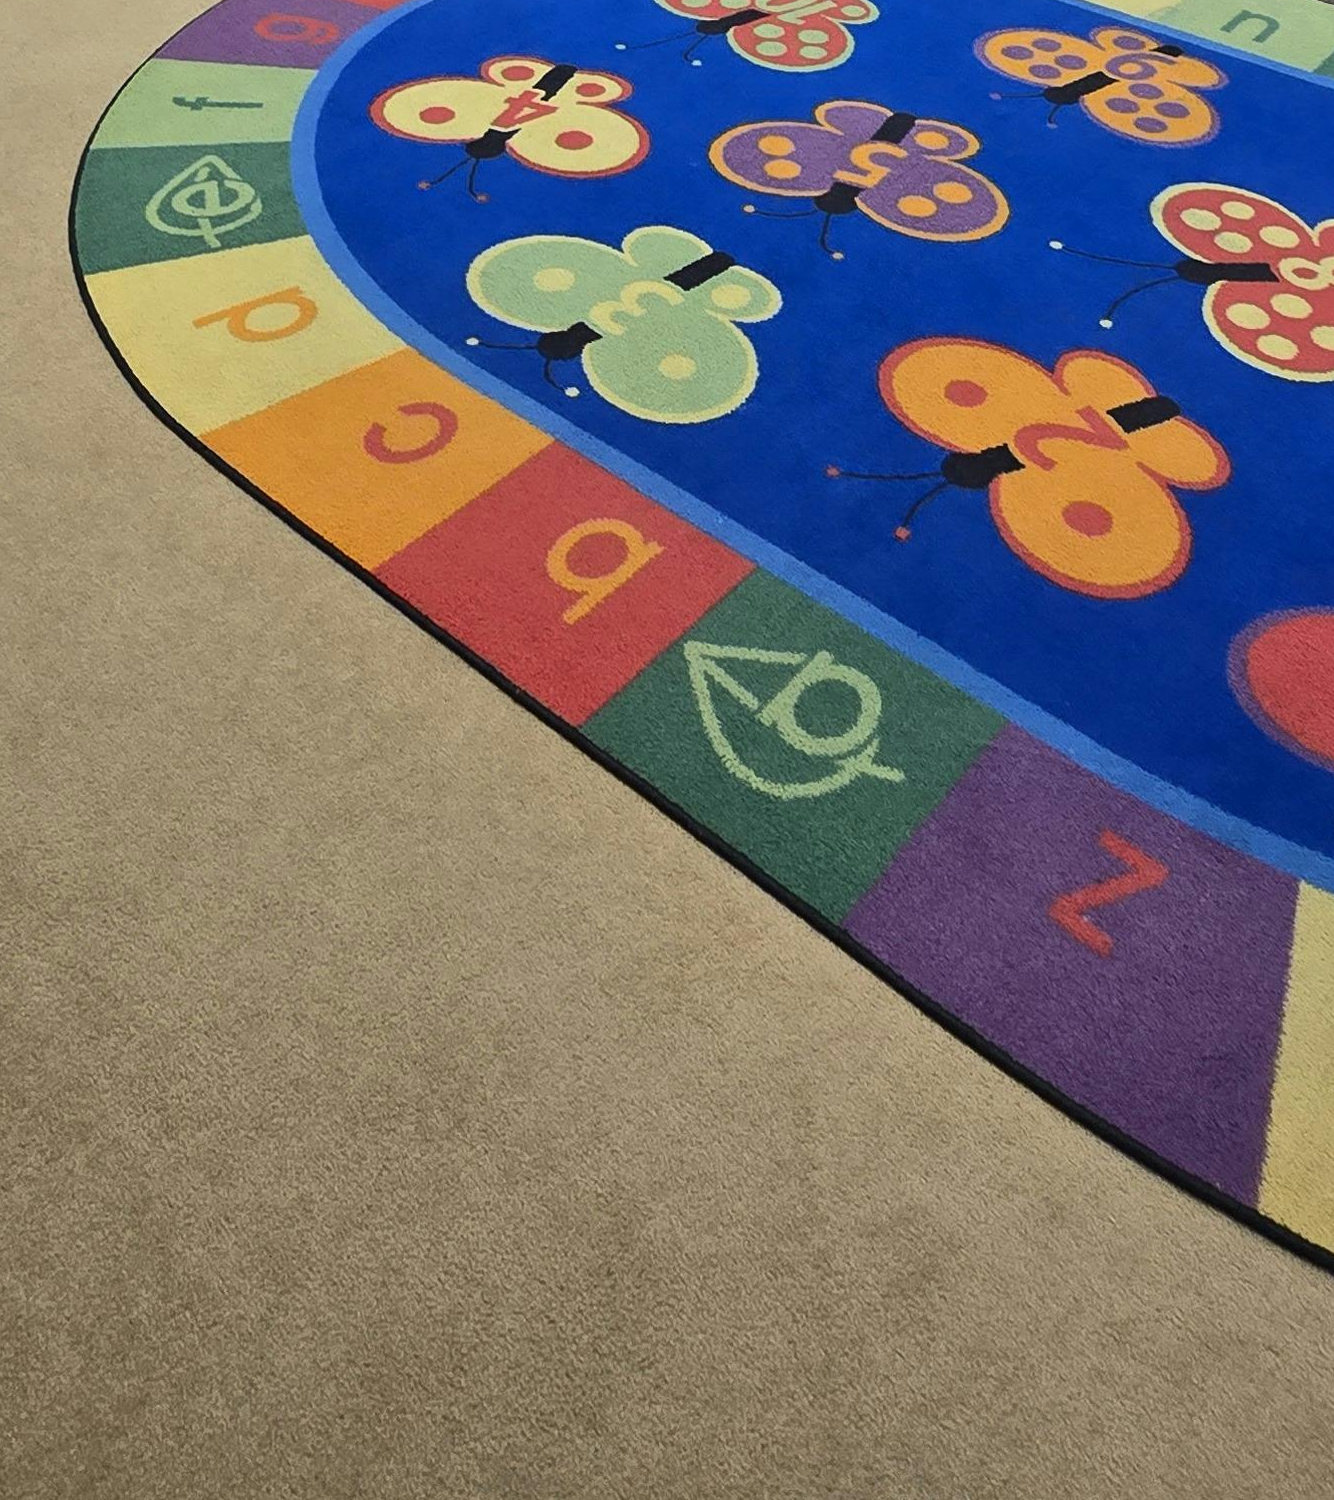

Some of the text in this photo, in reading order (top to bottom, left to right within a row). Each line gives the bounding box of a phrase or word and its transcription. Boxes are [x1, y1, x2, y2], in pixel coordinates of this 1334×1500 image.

[1220, 9, 1282, 44] n
[490, 89, 559, 130] 4
[588, 279, 686, 336] 3
[362, 400, 460, 465] c
[1011, 405, 1131, 473] 2
